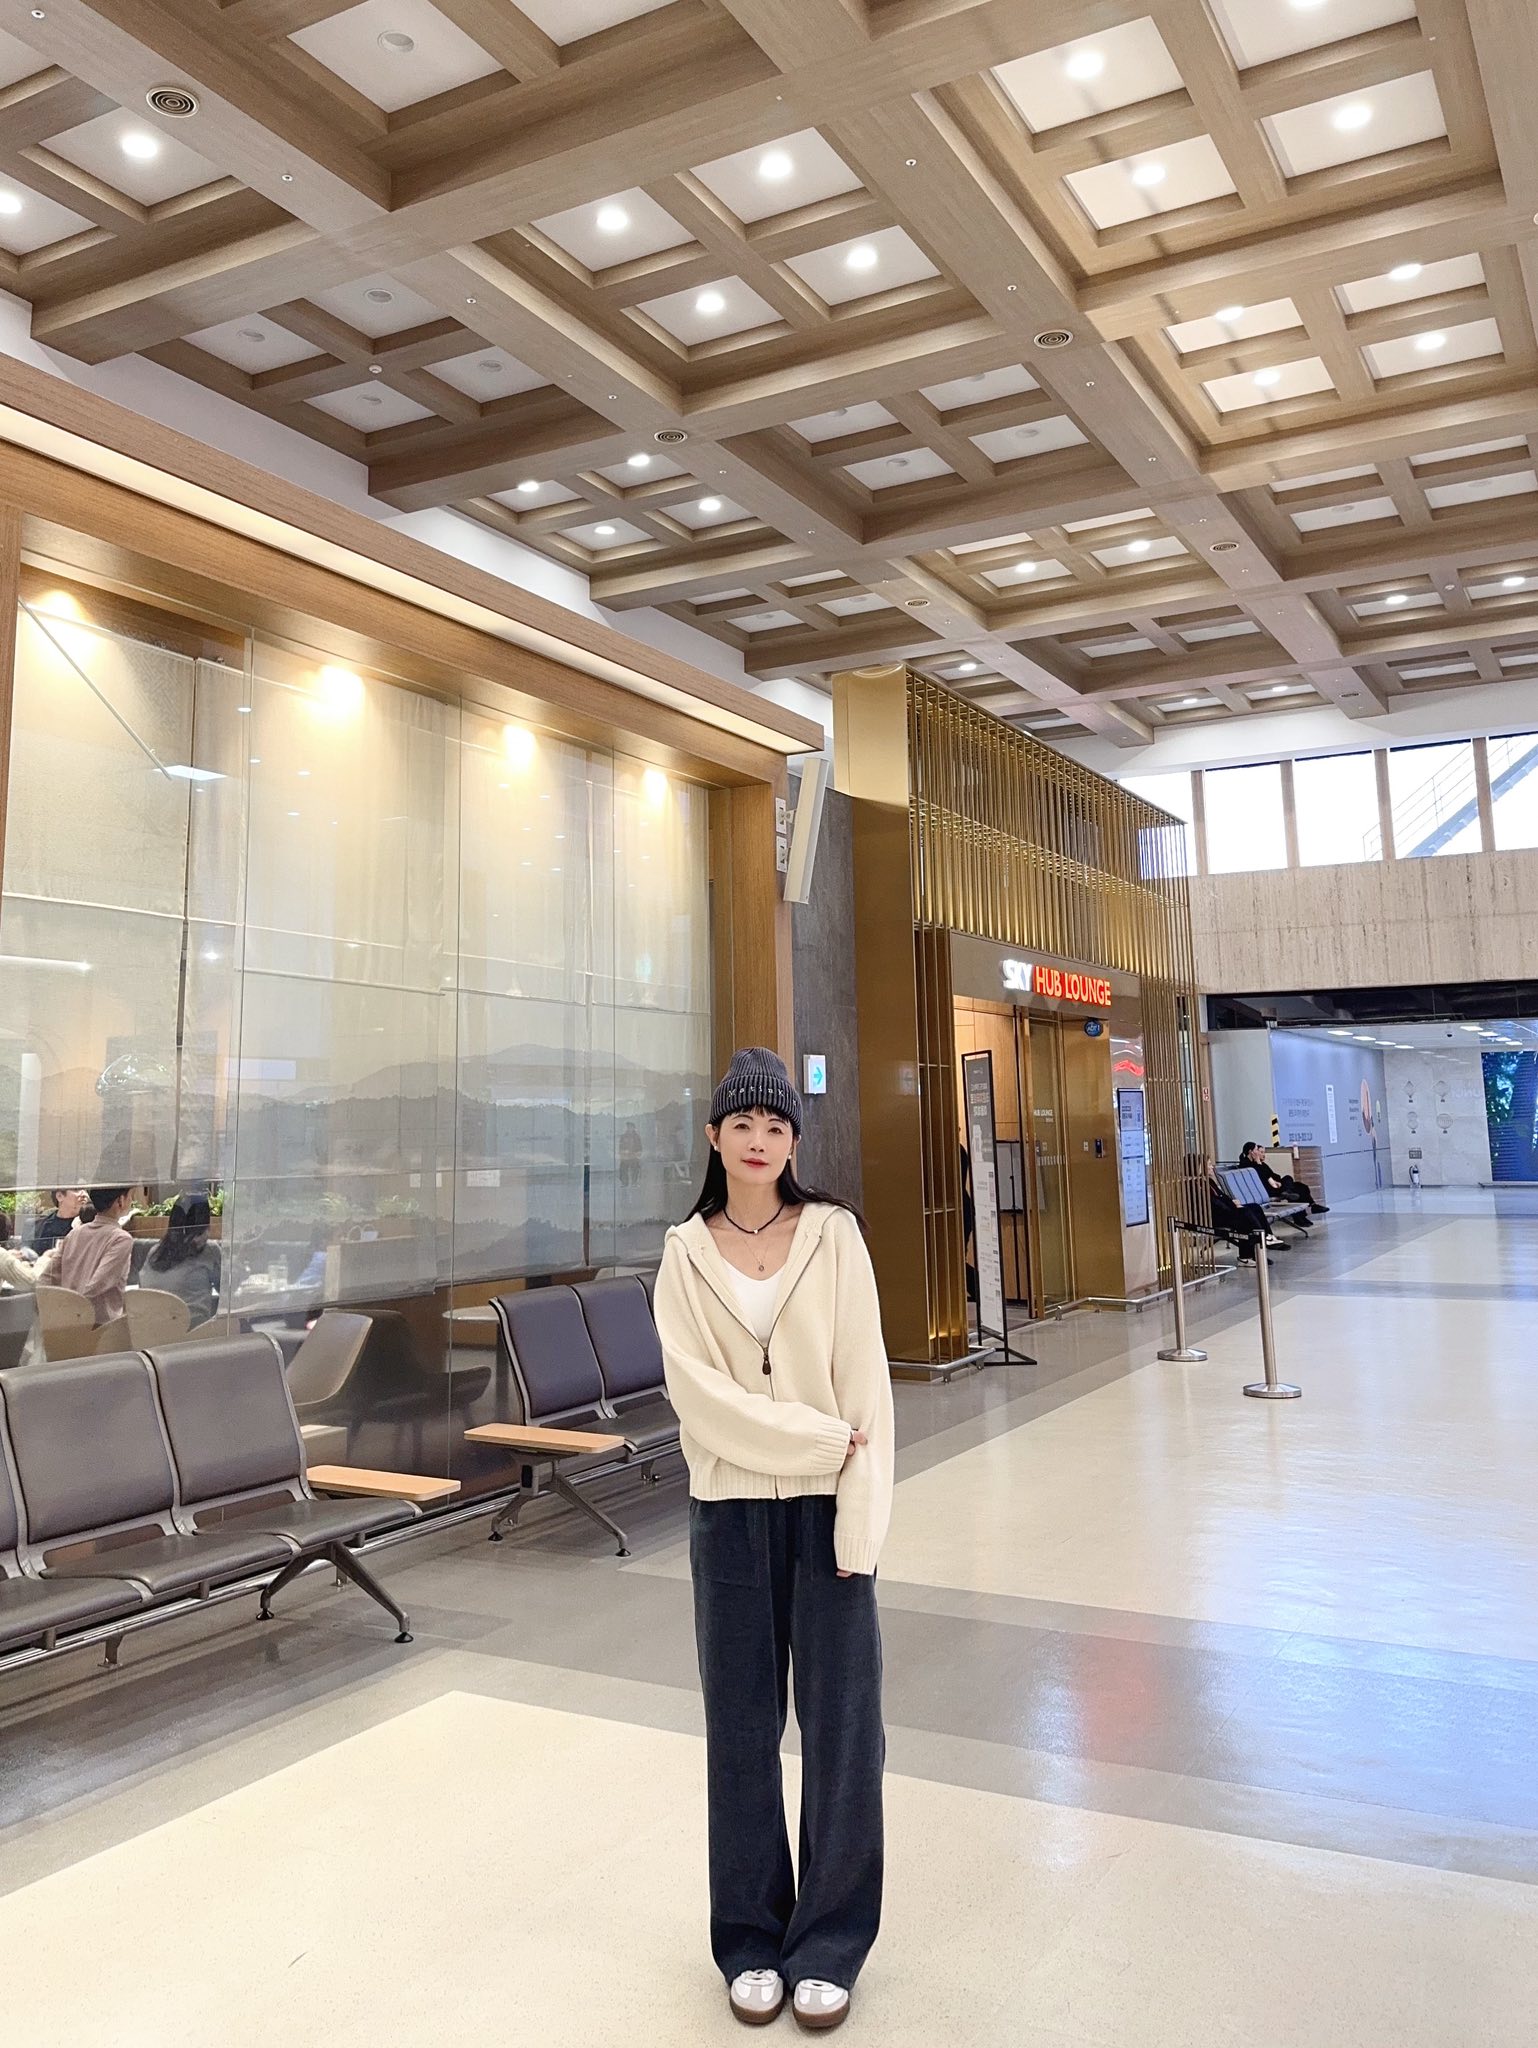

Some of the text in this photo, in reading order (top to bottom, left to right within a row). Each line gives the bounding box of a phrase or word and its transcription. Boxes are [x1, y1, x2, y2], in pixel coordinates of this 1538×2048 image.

[1002, 959, 1111, 1006] SKY HUB LOUNGE
